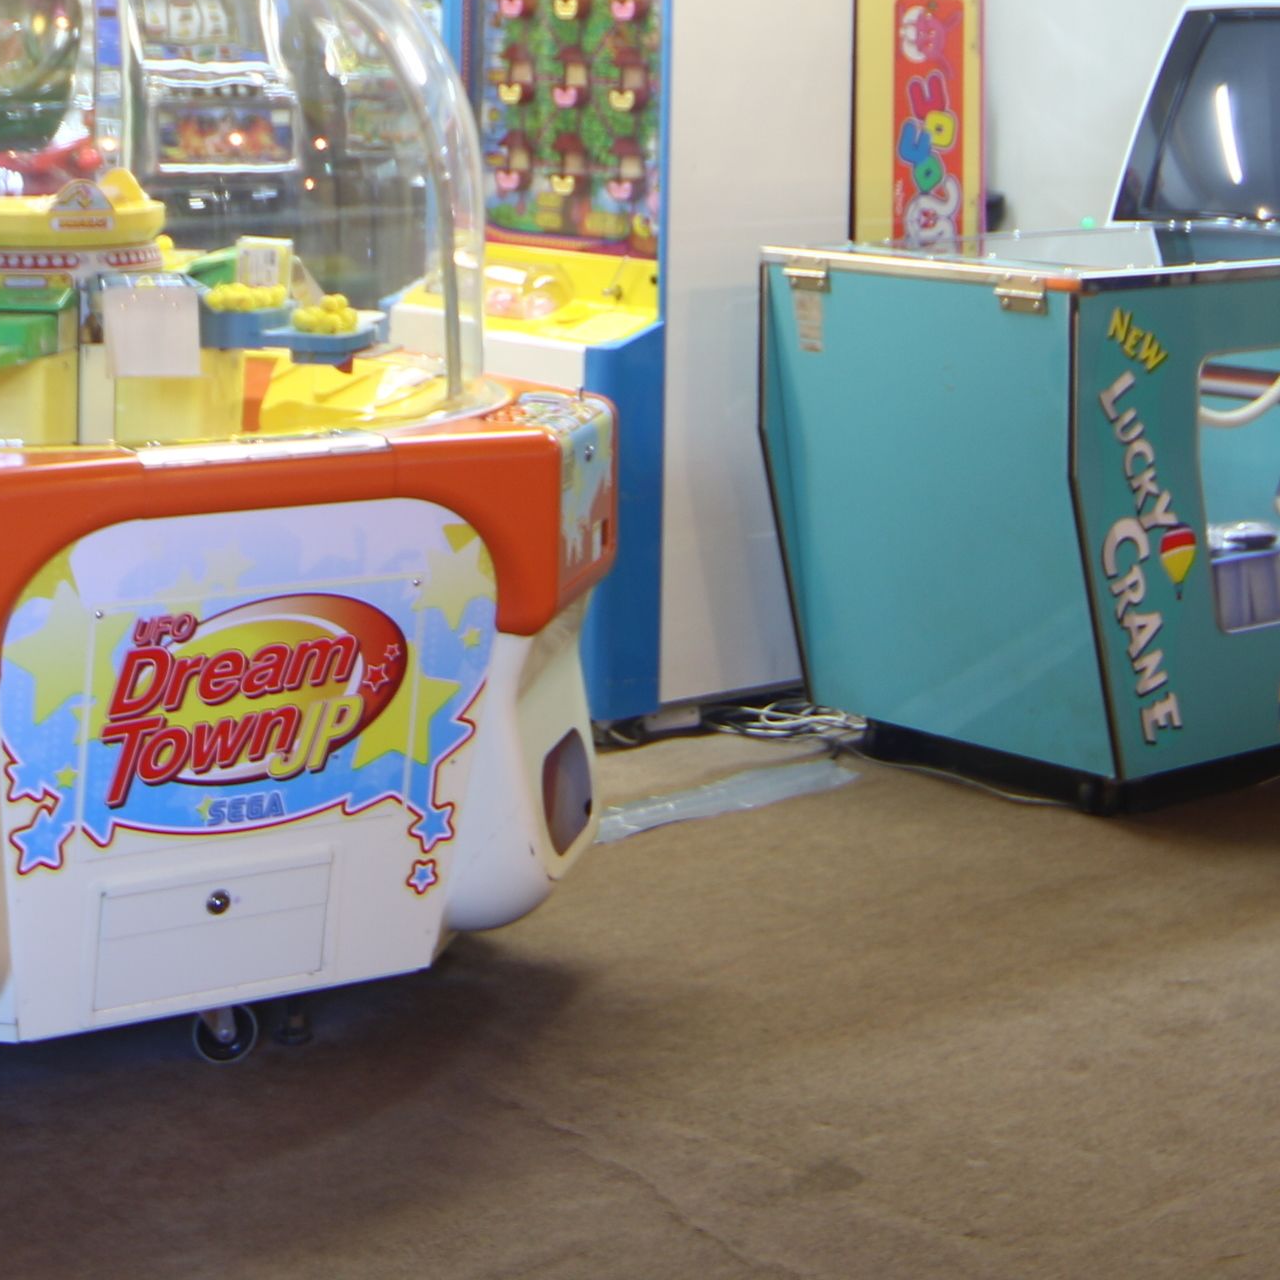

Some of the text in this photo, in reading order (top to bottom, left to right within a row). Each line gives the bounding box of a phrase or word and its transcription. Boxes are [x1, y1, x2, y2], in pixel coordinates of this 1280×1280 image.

[1106, 307, 1168, 374] NEW
[1099, 370, 1180, 533] LUCKY
[132, 613, 198, 647] UFO
[1100, 516, 1183, 746] CRANE
[107, 633, 360, 720] Dream
[100, 693, 365, 809] Town JP
[207, 790, 286, 826] SEGA
